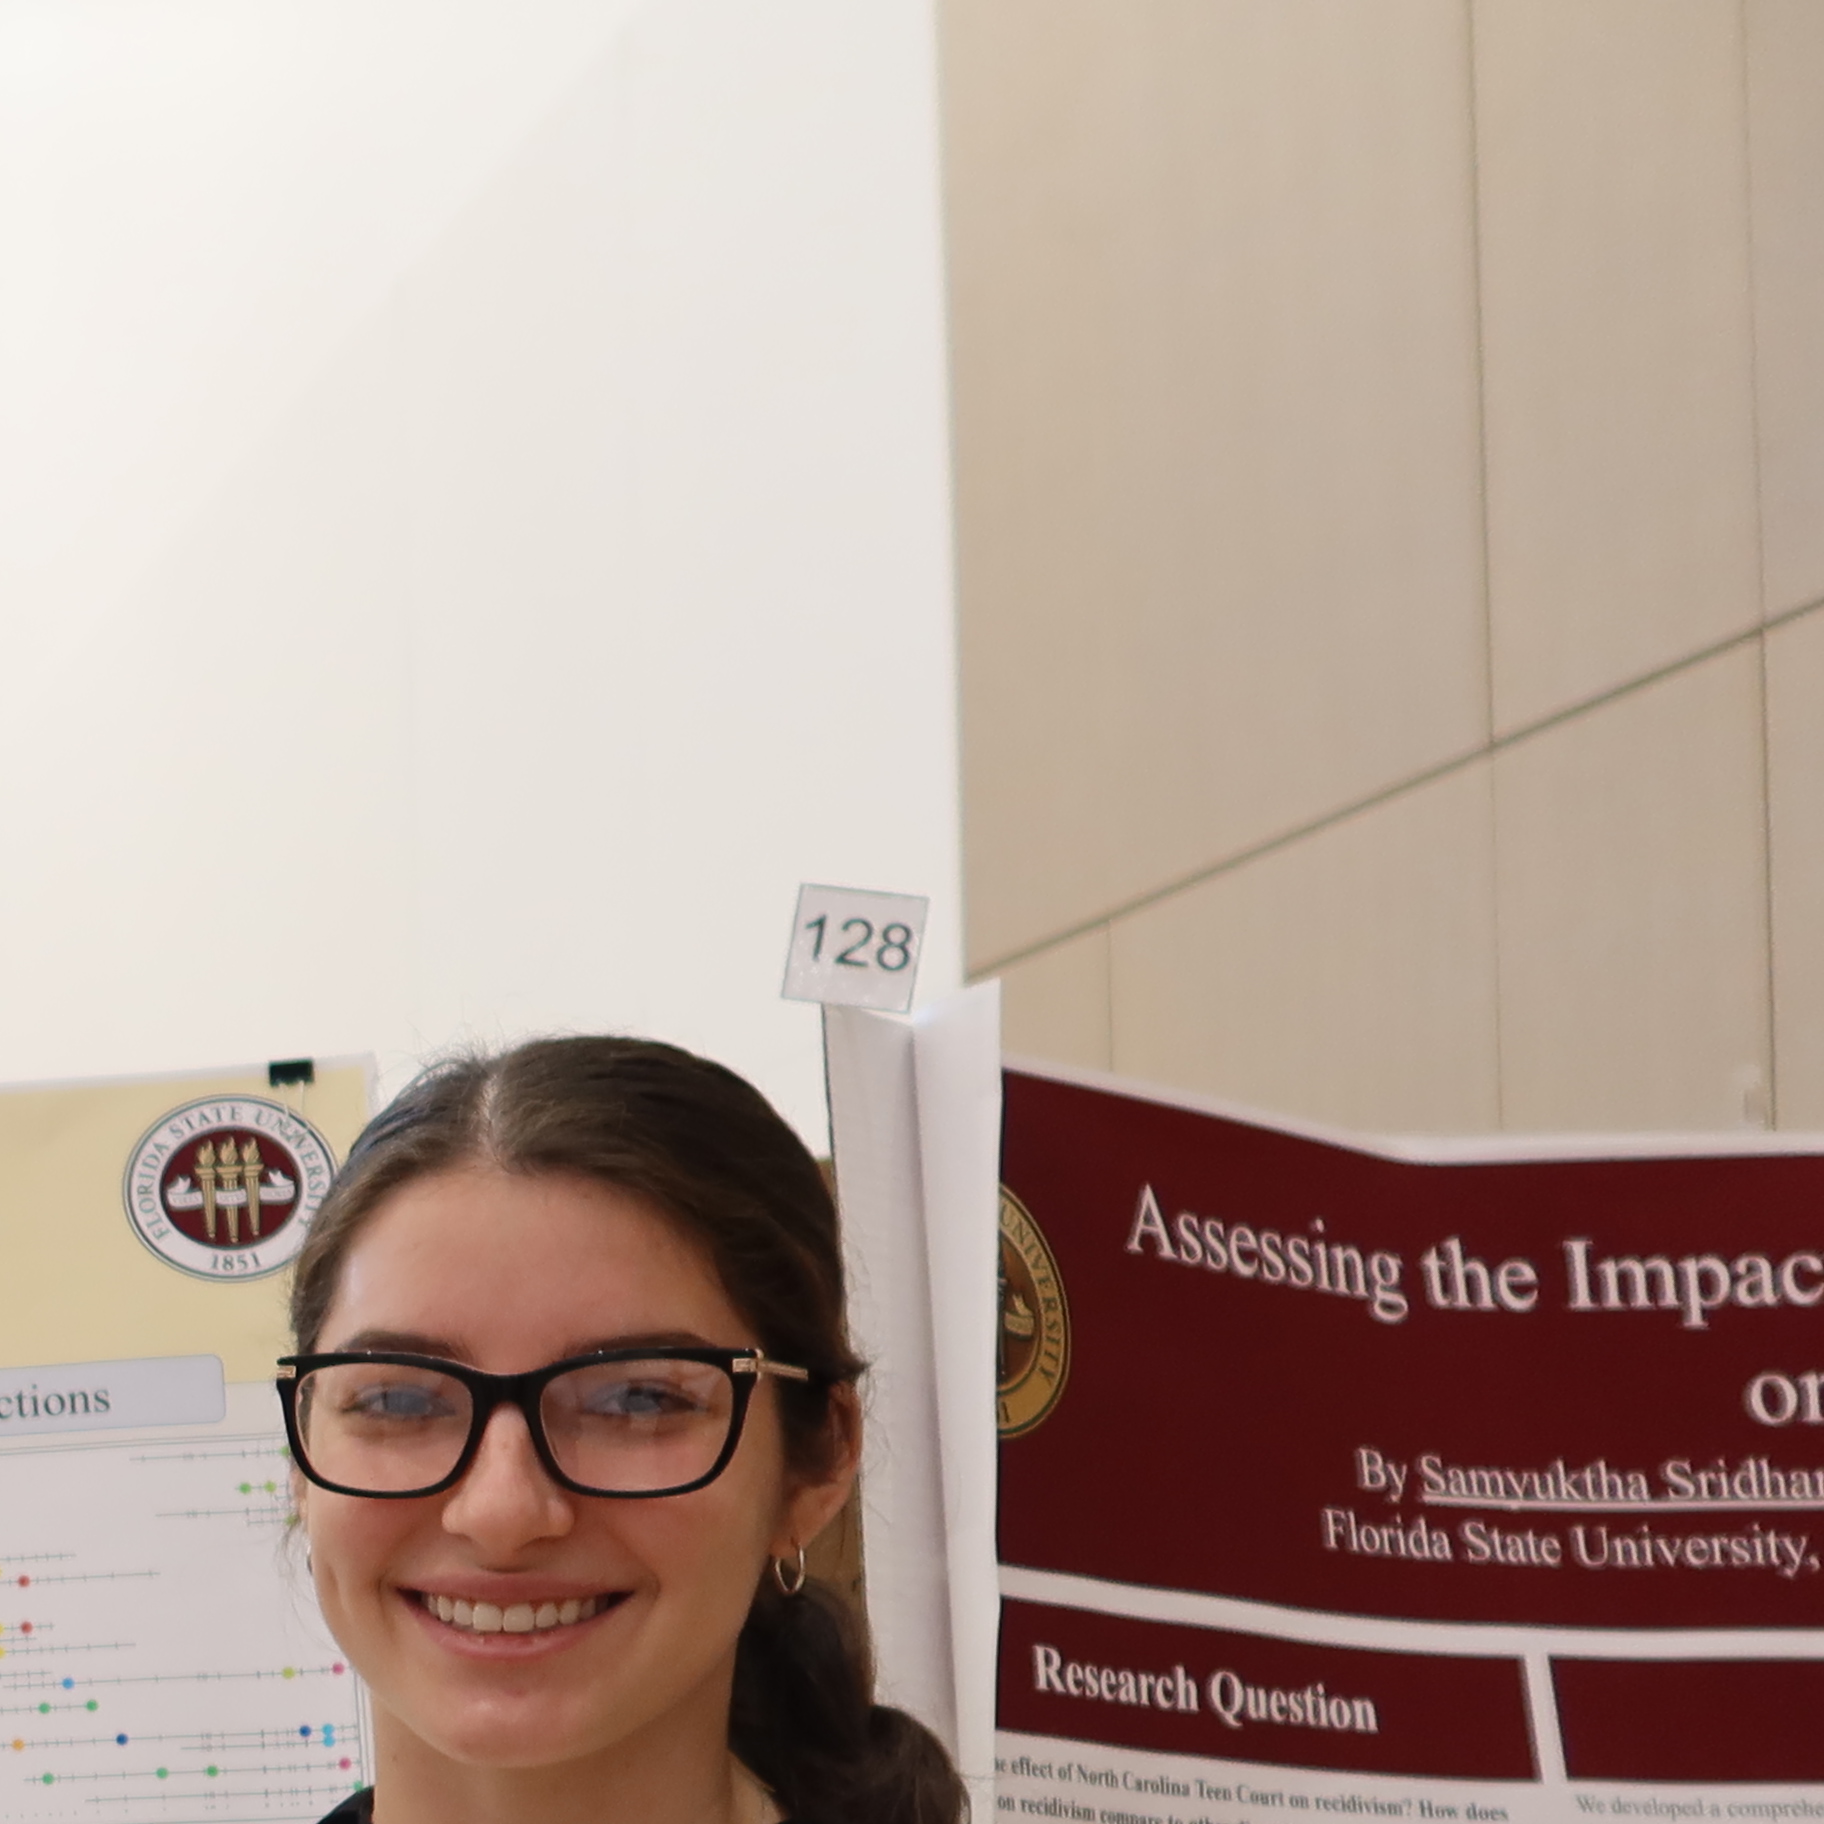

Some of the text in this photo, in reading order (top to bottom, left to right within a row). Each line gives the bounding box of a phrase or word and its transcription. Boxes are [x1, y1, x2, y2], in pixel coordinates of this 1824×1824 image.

[805, 914, 913, 972] 128
[137, 1142, 171, 1240] FLORIDA
[169, 1106, 244, 1139] STATE
[210, 1253, 262, 1271] 1851
[1126, 1182, 1824, 1328] Assessing the Impac
[1356, 1445, 1408, 1502] By
[1322, 1507, 1821, 1580] Florida State University,
[1032, 1644, 1379, 1731] Research Question
